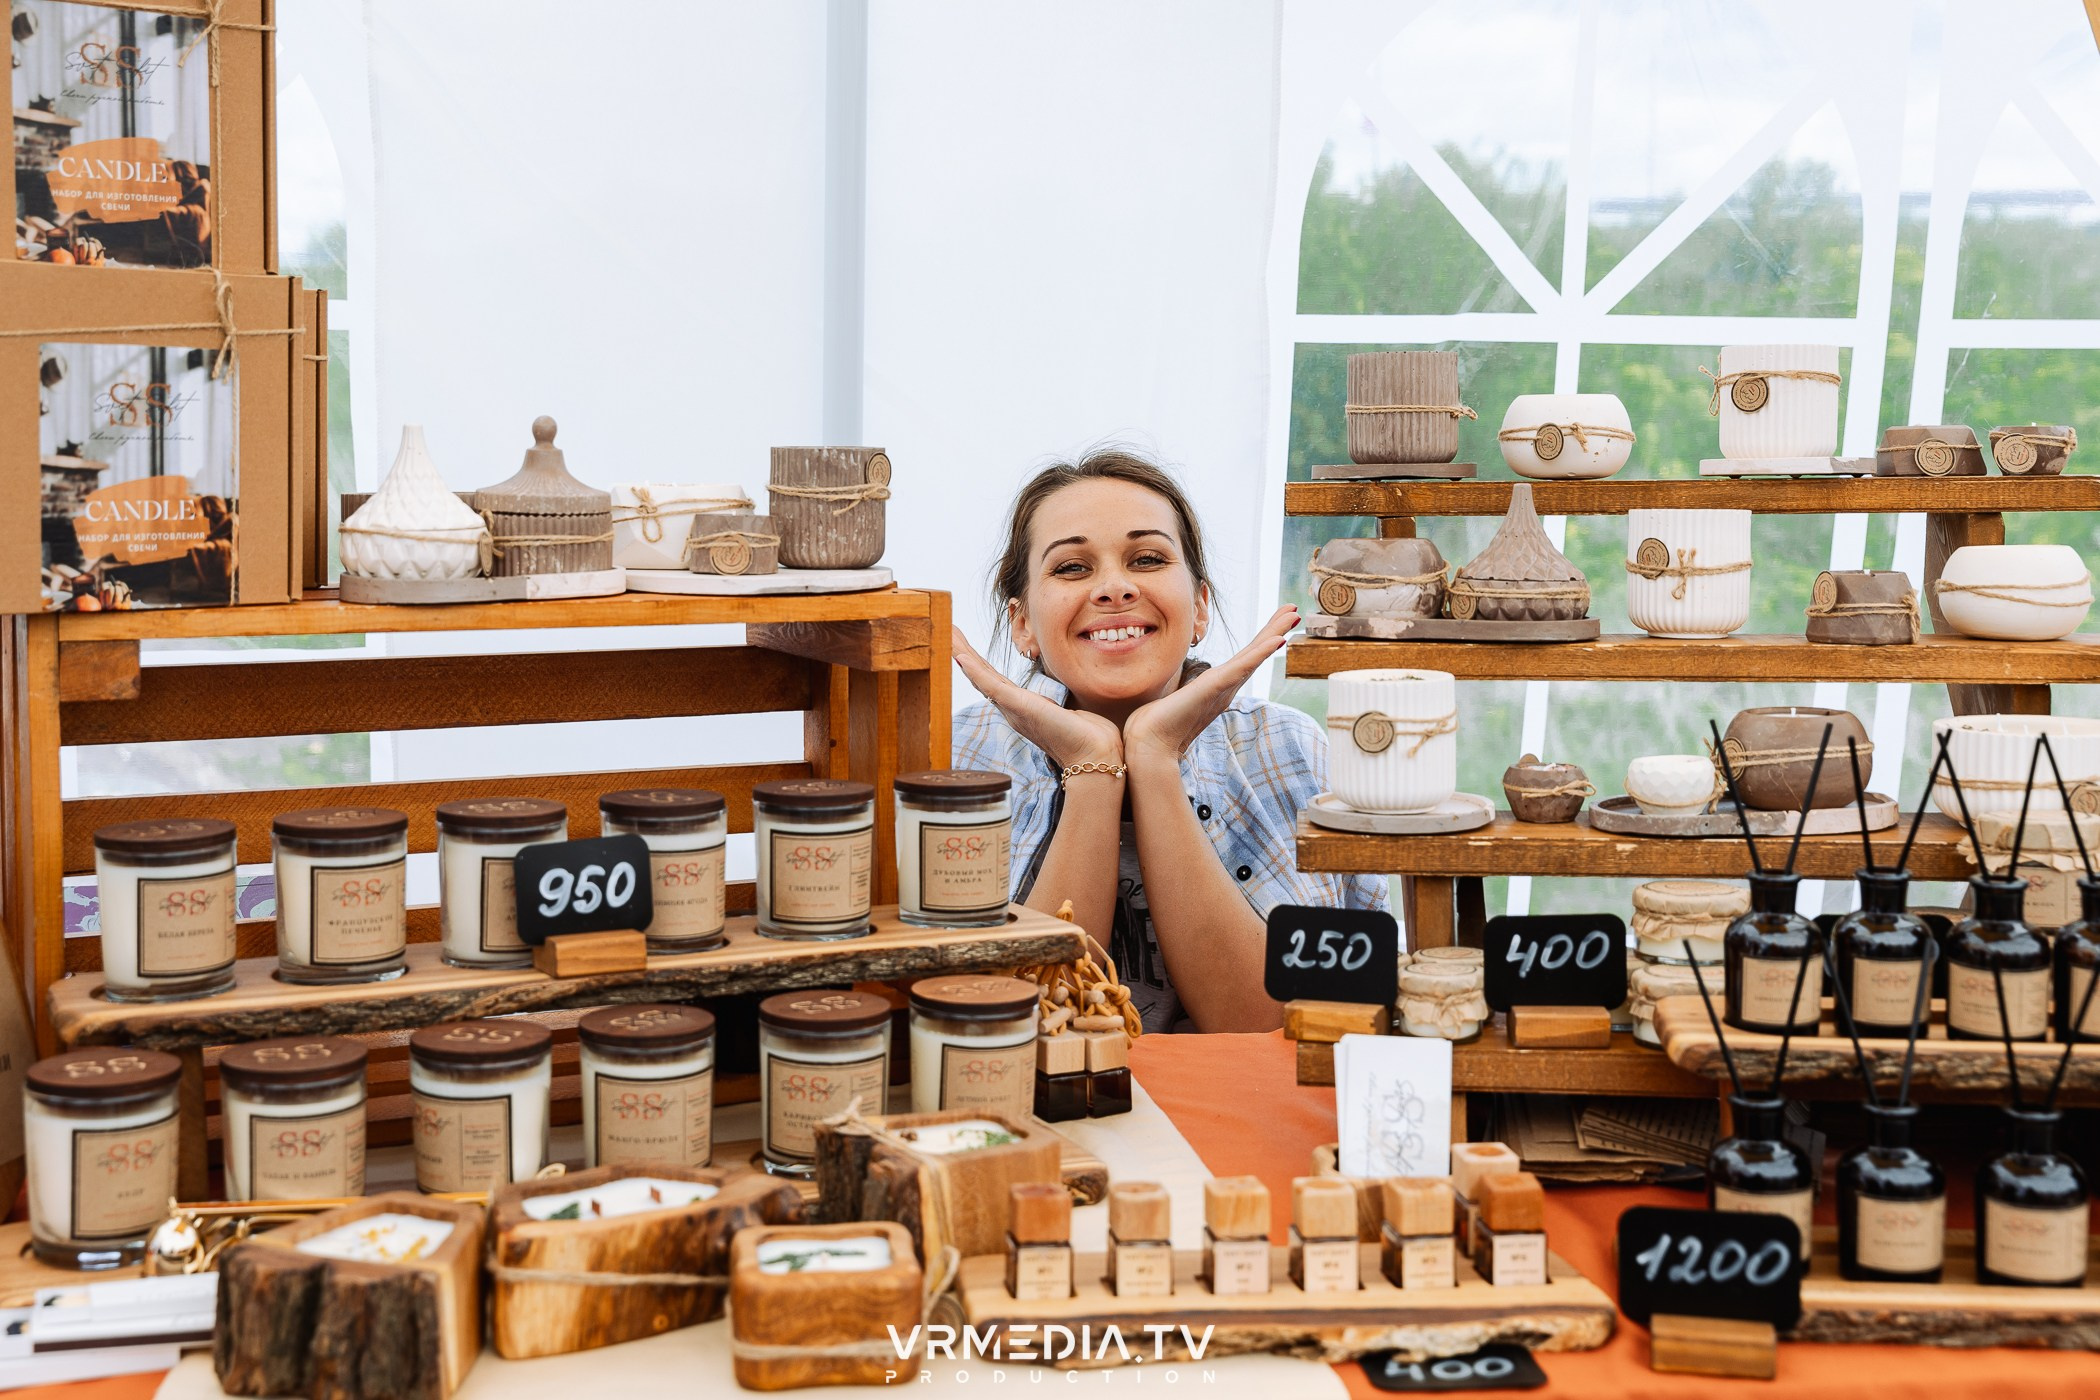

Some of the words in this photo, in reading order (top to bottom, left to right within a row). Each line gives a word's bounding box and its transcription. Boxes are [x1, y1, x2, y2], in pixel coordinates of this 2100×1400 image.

[58, 157, 168, 184] CANDLE
[52, 188, 82, 198] НАБОР
[85, 191, 104, 200] ДЛЯ
[107, 193, 177, 203] ИЗГОТОВЛЕНИЯ
[101, 202, 130, 211] СВЕЧИ
[84, 500, 196, 522] CANDLE
[78, 534, 109, 543] НАБОР
[112, 533, 131, 543] ДЛЯ
[134, 531, 205, 541] ИЗГОТОВЛЕНИЯ
[128, 544, 158, 552] СВЕЧИ
[538, 861, 636, 918] 950
[1282, 929, 1373, 971] 250
[1506, 930, 1610, 979] 400
[1636, 1233, 1791, 1287] 1200
[1384, 1356, 1515, 1383] 400
